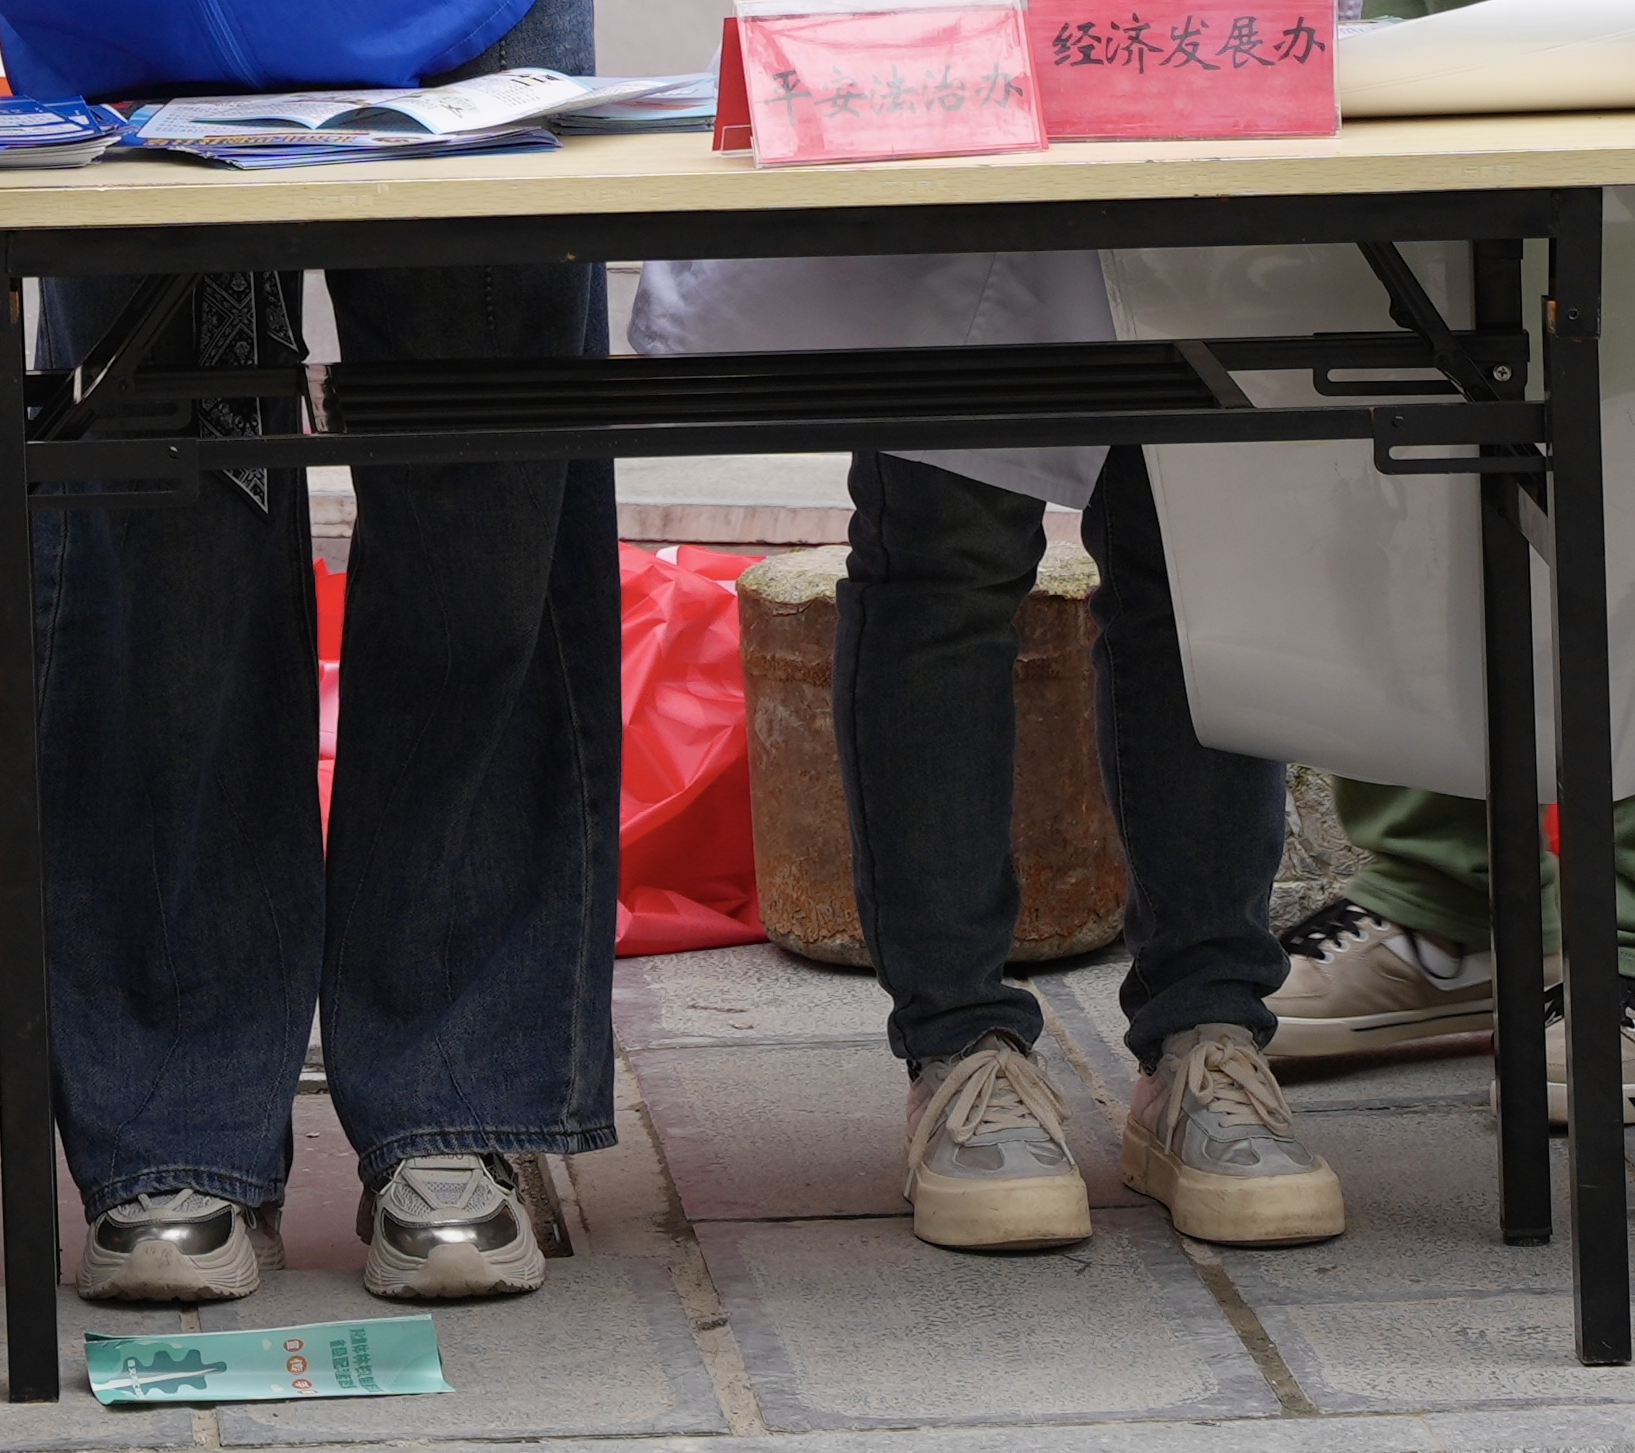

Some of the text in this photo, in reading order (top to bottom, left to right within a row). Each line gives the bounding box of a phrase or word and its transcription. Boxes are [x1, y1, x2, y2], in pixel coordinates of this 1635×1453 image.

[1051, 14, 1326, 74] 经济发展办
[763, 63, 1024, 127] 平安法治办
